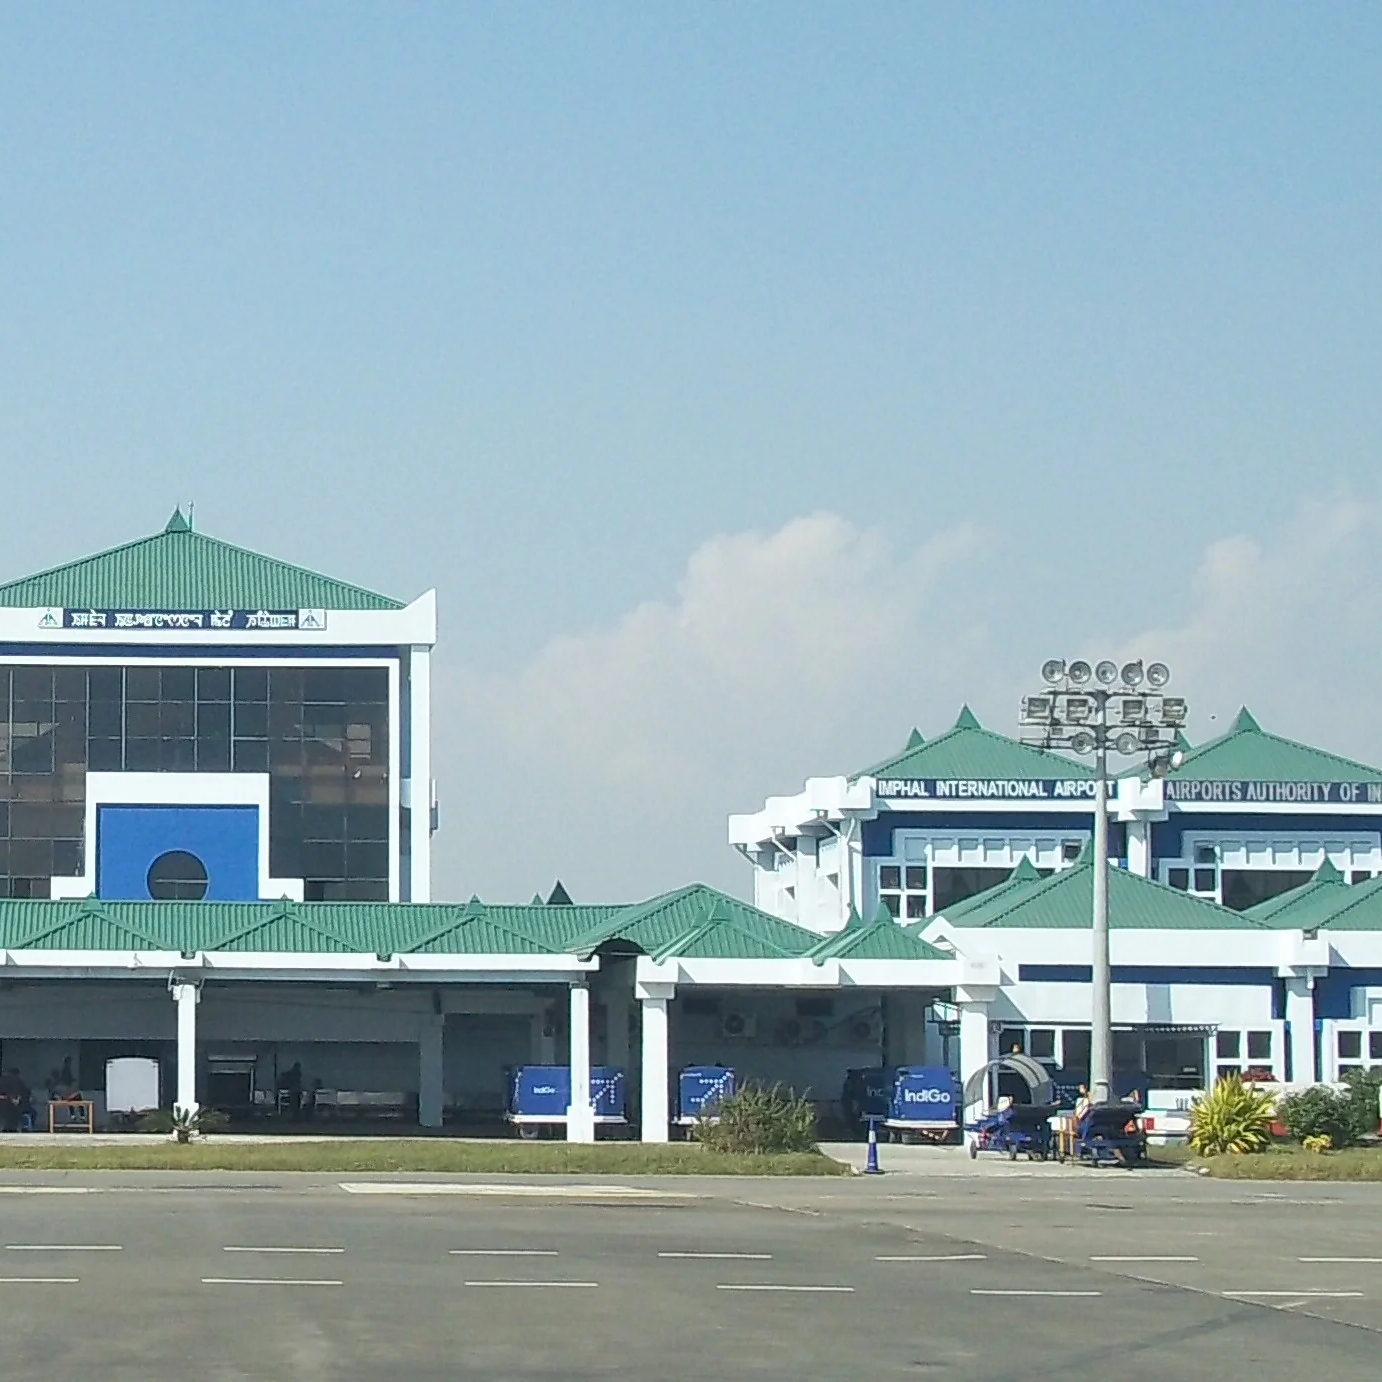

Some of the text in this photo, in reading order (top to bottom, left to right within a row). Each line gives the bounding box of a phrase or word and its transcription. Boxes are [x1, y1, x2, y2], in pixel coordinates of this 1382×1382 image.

[878, 779, 1116, 798] IMPHAL INTERNATIONAL AIRPOT
[1166, 780, 1242, 800] AIRPORTS
[1246, 782, 1332, 801] AUTHORITY
[1339, 782, 1361, 802] OF
[904, 1088, 951, 1103] IndiGo
